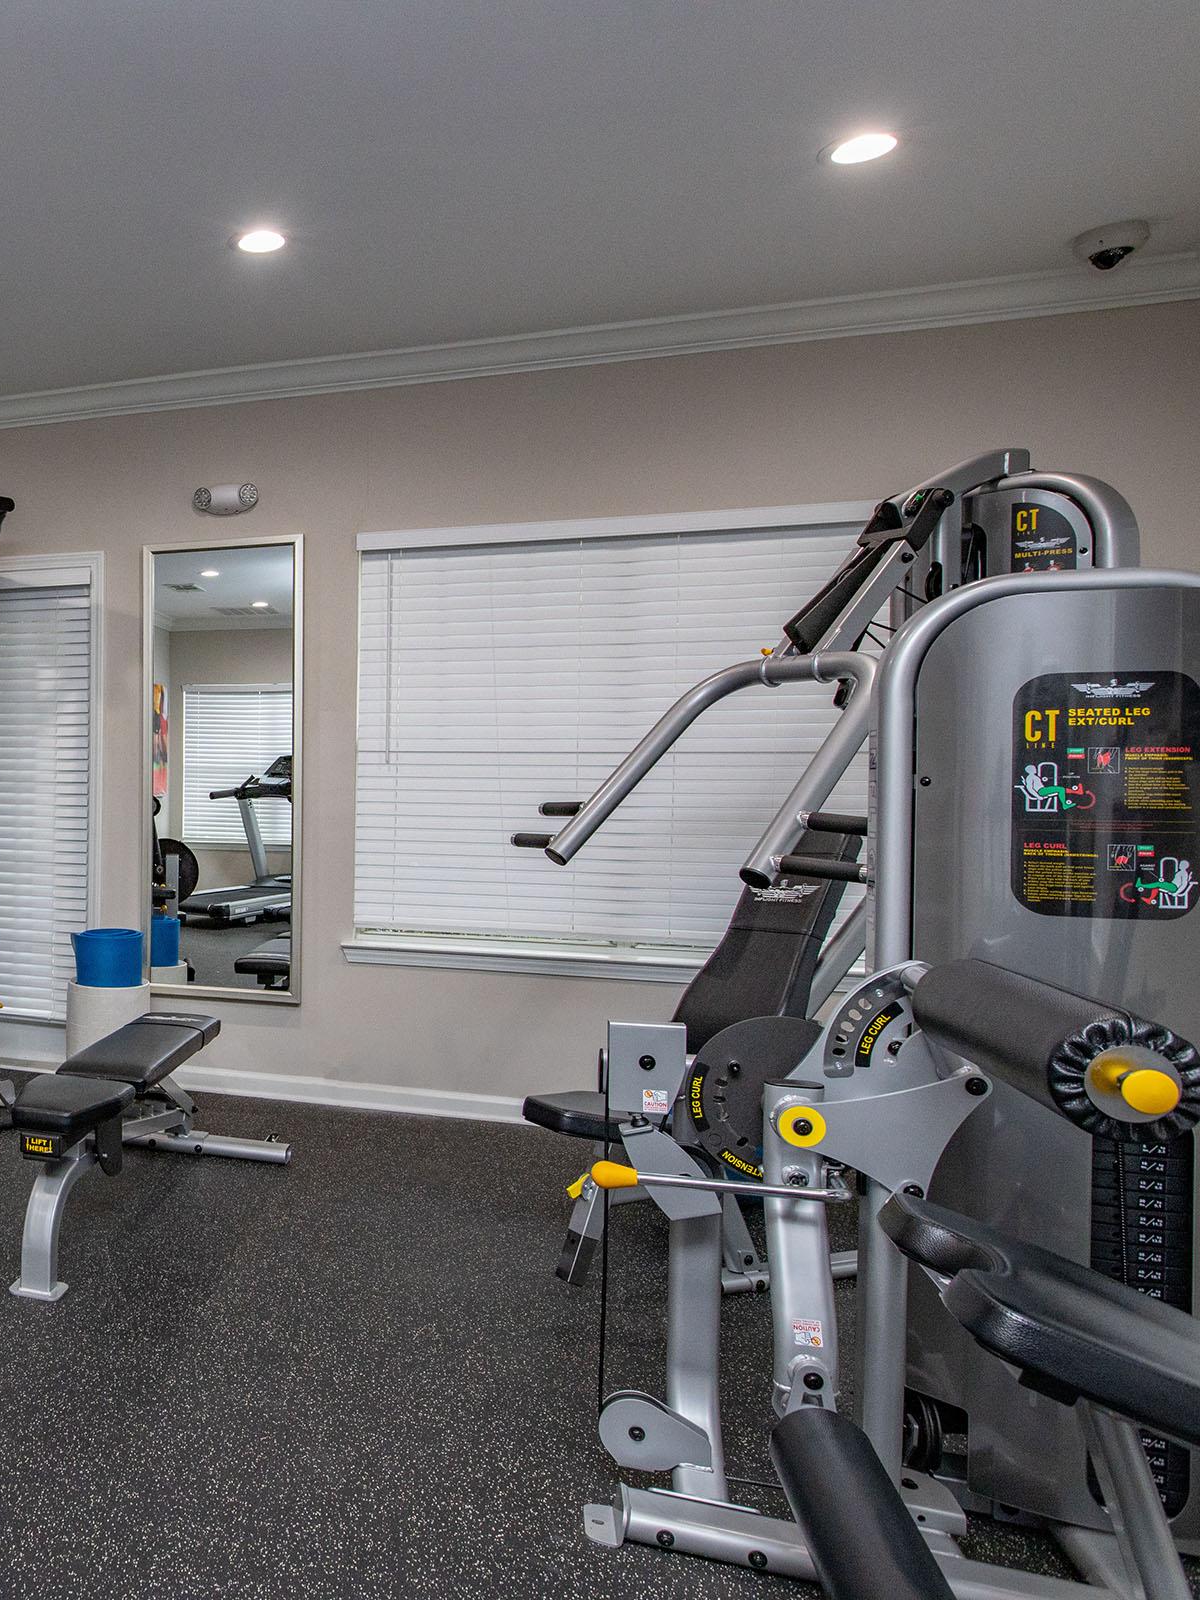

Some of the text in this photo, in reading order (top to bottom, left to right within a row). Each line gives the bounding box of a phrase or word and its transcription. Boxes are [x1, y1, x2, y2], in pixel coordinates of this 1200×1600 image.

[1016, 508, 1040, 531] CT
[1014, 547, 1073, 559] MULTI-PRESS
[1068, 707, 1151, 716] SEATED LEG
[1024, 709, 1060, 742] CT
[1068, 717, 1135, 726] EXT/CURL
[859, 1014, 892, 1055] LEG CURL
[691, 1076, 703, 1119] LEG CURL
[31, 1137, 47, 1146] LIFT
[792, 1324, 821, 1332] CAUTION
